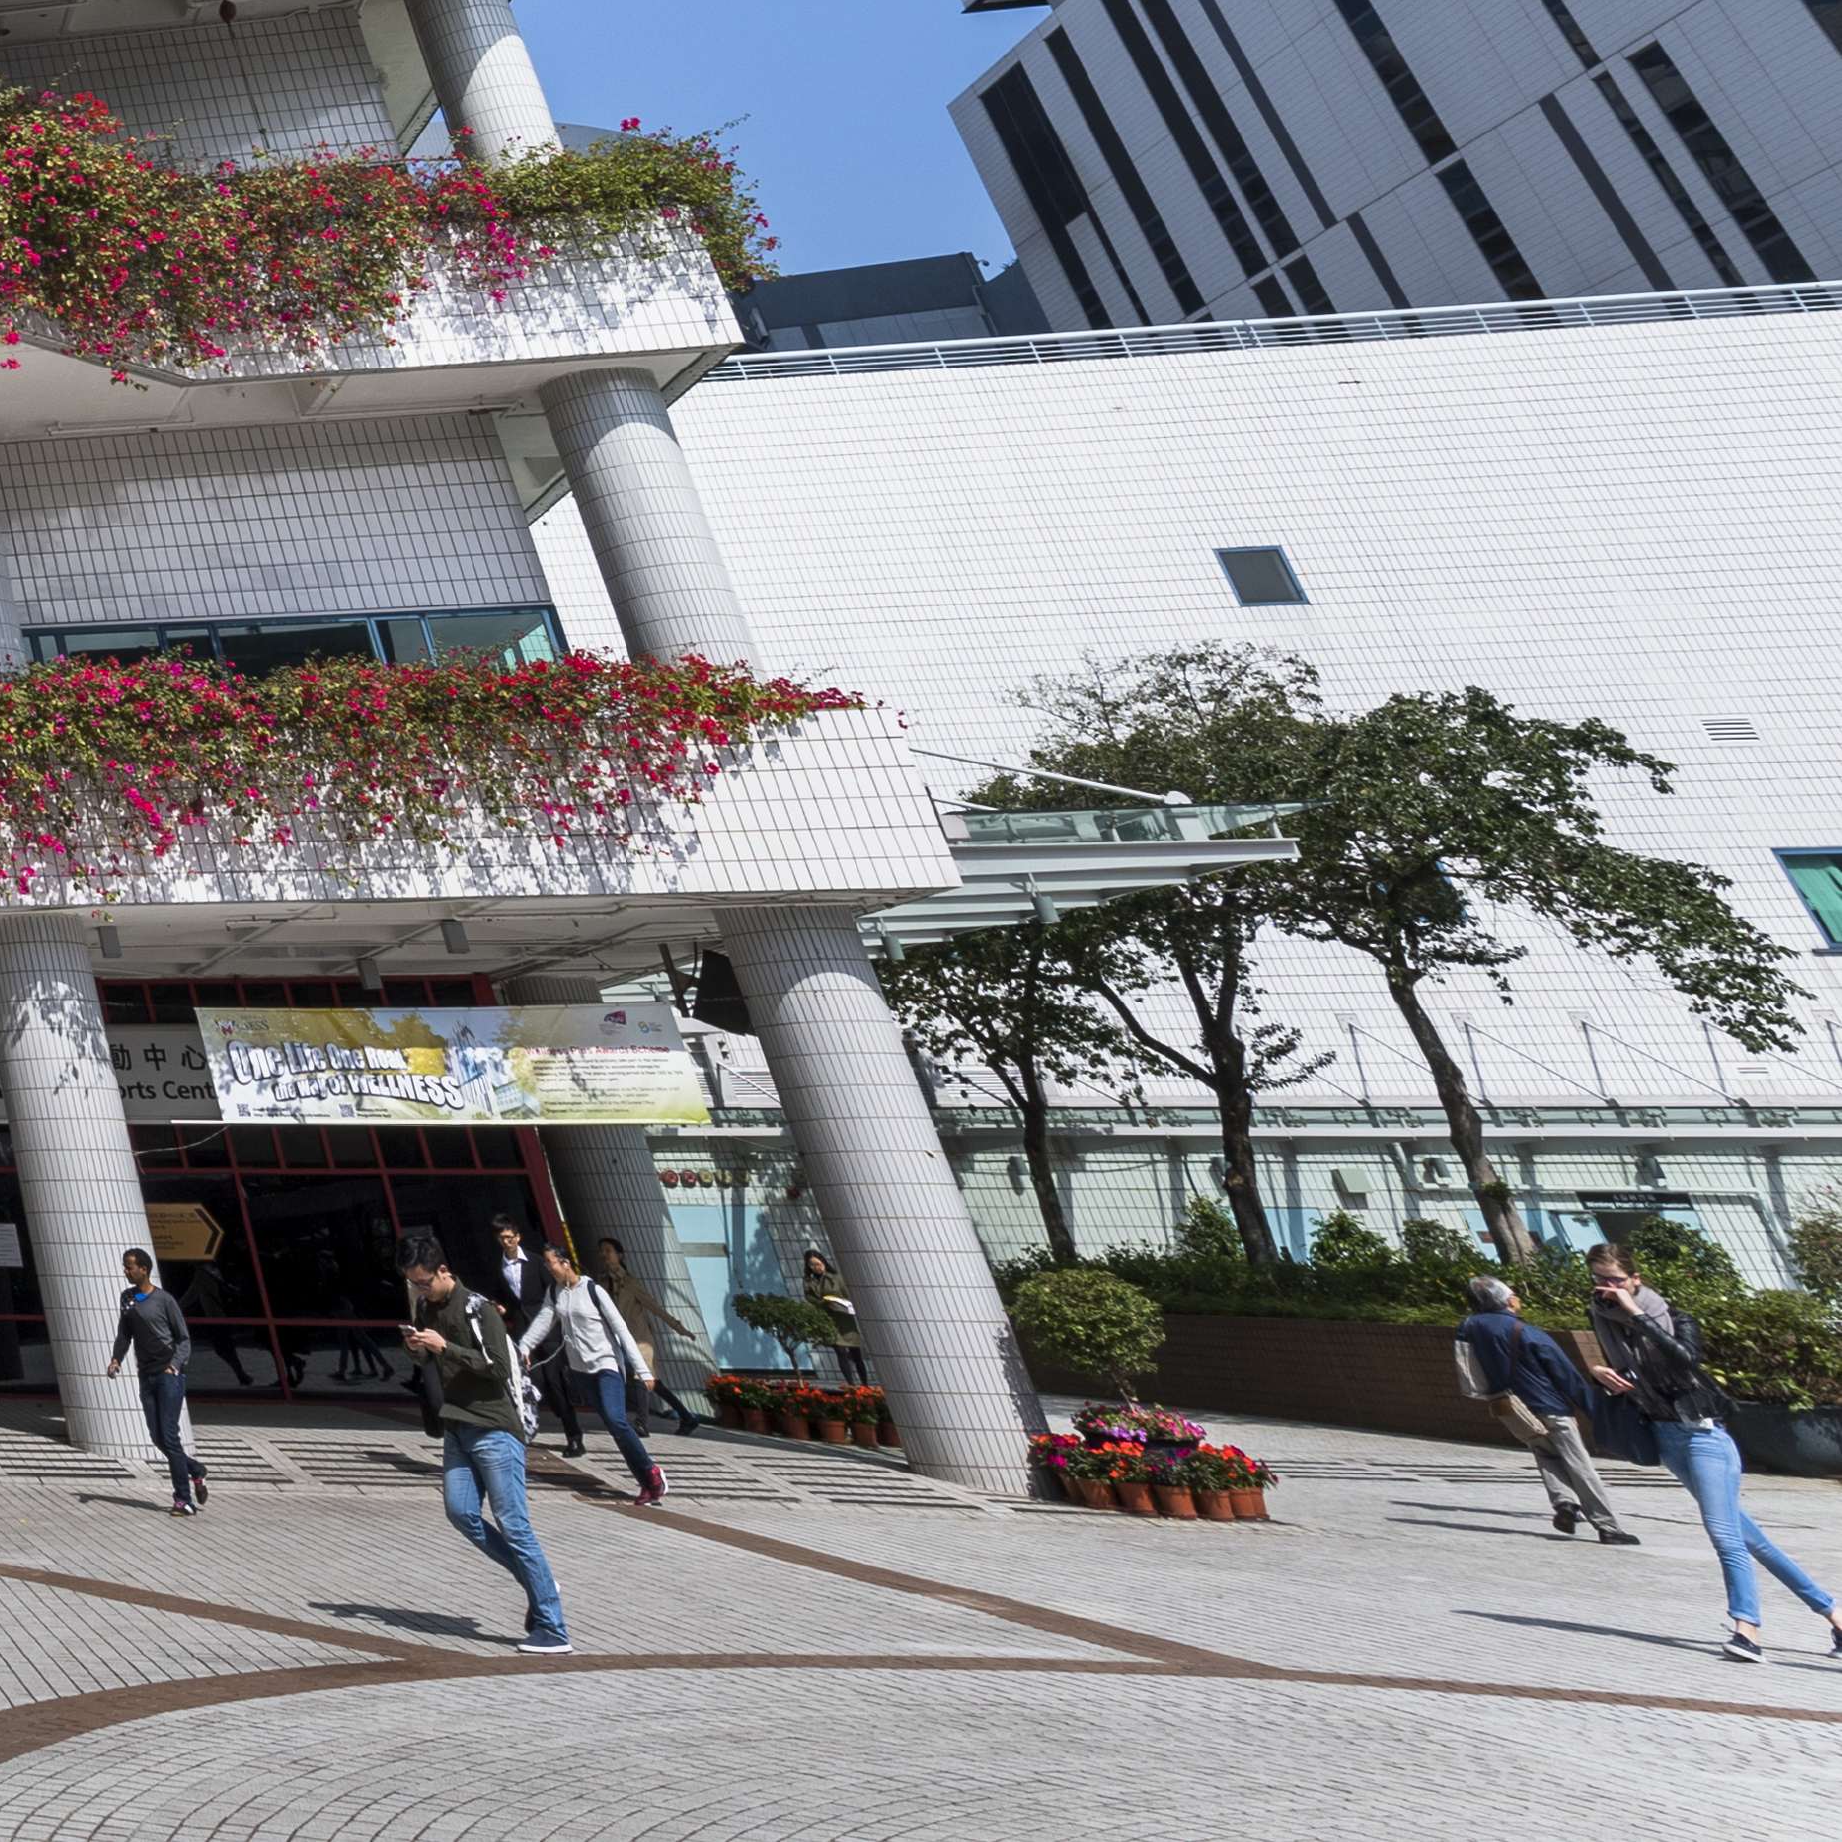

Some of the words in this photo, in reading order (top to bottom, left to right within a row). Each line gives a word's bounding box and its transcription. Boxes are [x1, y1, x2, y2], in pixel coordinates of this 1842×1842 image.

[226, 1039, 285, 1085] One
[283, 1041, 327, 1075] Life
[325, 1042, 366, 1071] One
[119, 1080, 156, 1099] orts
[163, 1080, 216, 1099] Cent
[348, 1073, 466, 1109] WELLNESS
